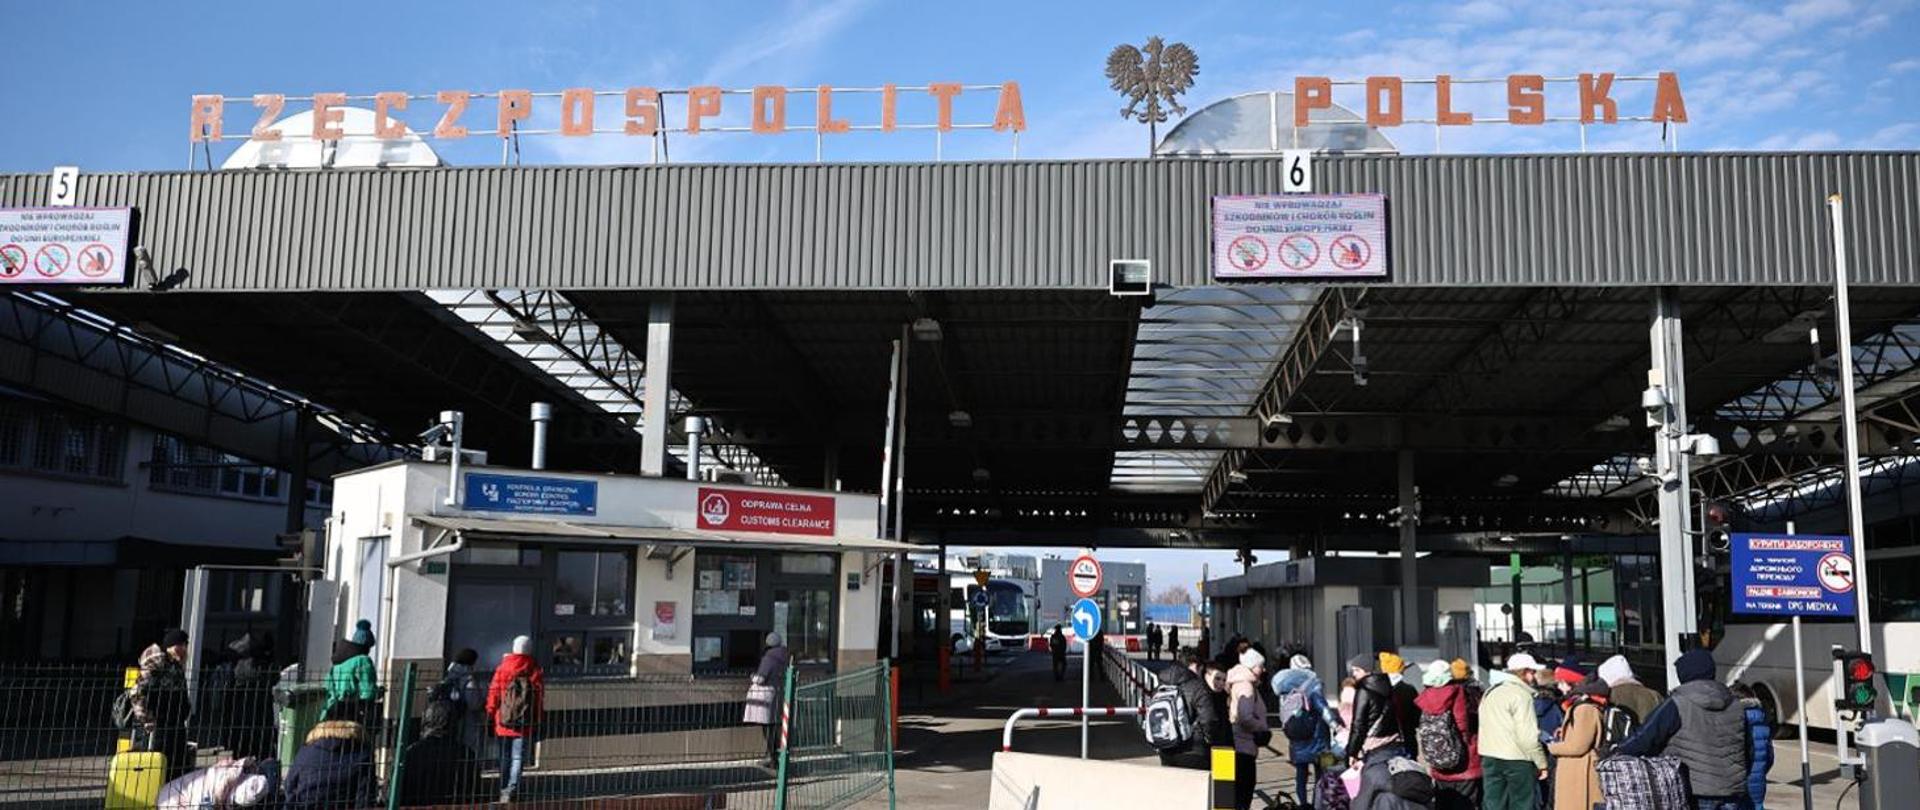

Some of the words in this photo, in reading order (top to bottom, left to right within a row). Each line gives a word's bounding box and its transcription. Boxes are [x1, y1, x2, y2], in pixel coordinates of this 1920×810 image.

[190, 81, 1027, 141] RZECZPOSPOLITA
[1295, 72, 1687, 127] POLSKA
[1290, 155, 1304, 186] 6
[57, 173, 70, 199] 5
[1254, 201, 1270, 209] NIE
[1273, 201, 1342, 209] WPROWADZAJ
[1224, 211, 1289, 221] SZKODNIKÓW
[1296, 211, 1337, 220] CHORÓB
[740, 499, 783, 511] ODPRAWA
[785, 502, 811, 512] CELNA
[740, 515, 780, 526] CUSTOMS
[782, 517, 830, 529] CLEARANCE
[1806, 602, 1838, 611] MEDYKA
